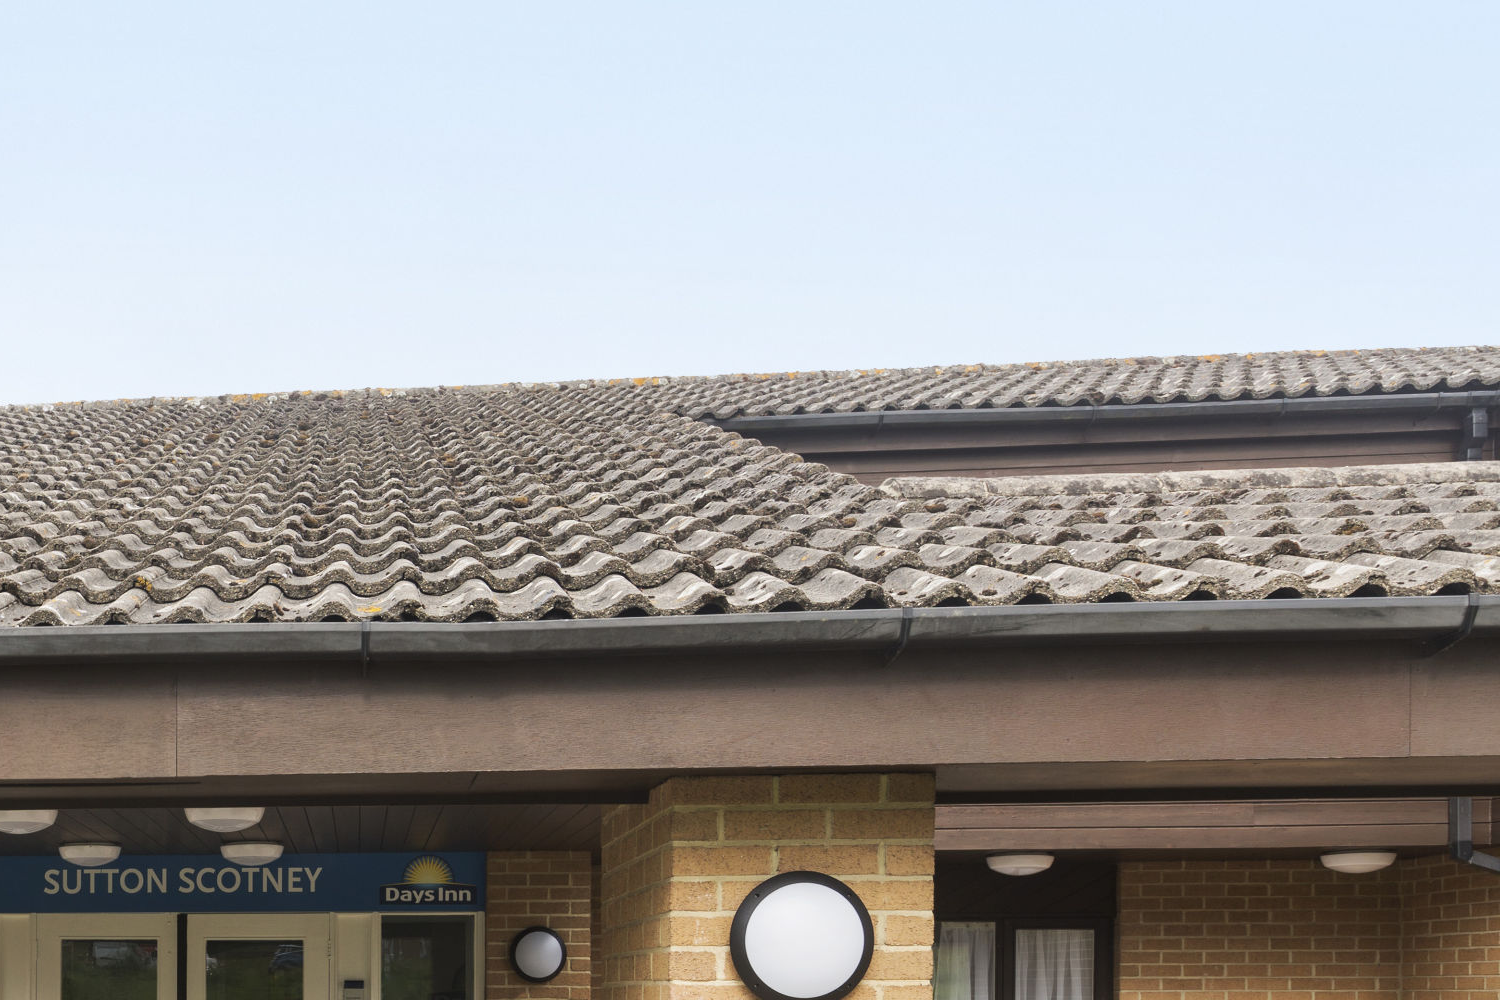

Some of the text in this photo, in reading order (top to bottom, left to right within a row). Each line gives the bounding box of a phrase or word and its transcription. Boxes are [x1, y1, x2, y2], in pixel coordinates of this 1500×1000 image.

[43, 867, 323, 894] SUTTON SCOTNEY
[385, 887, 472, 904] Days Inn
